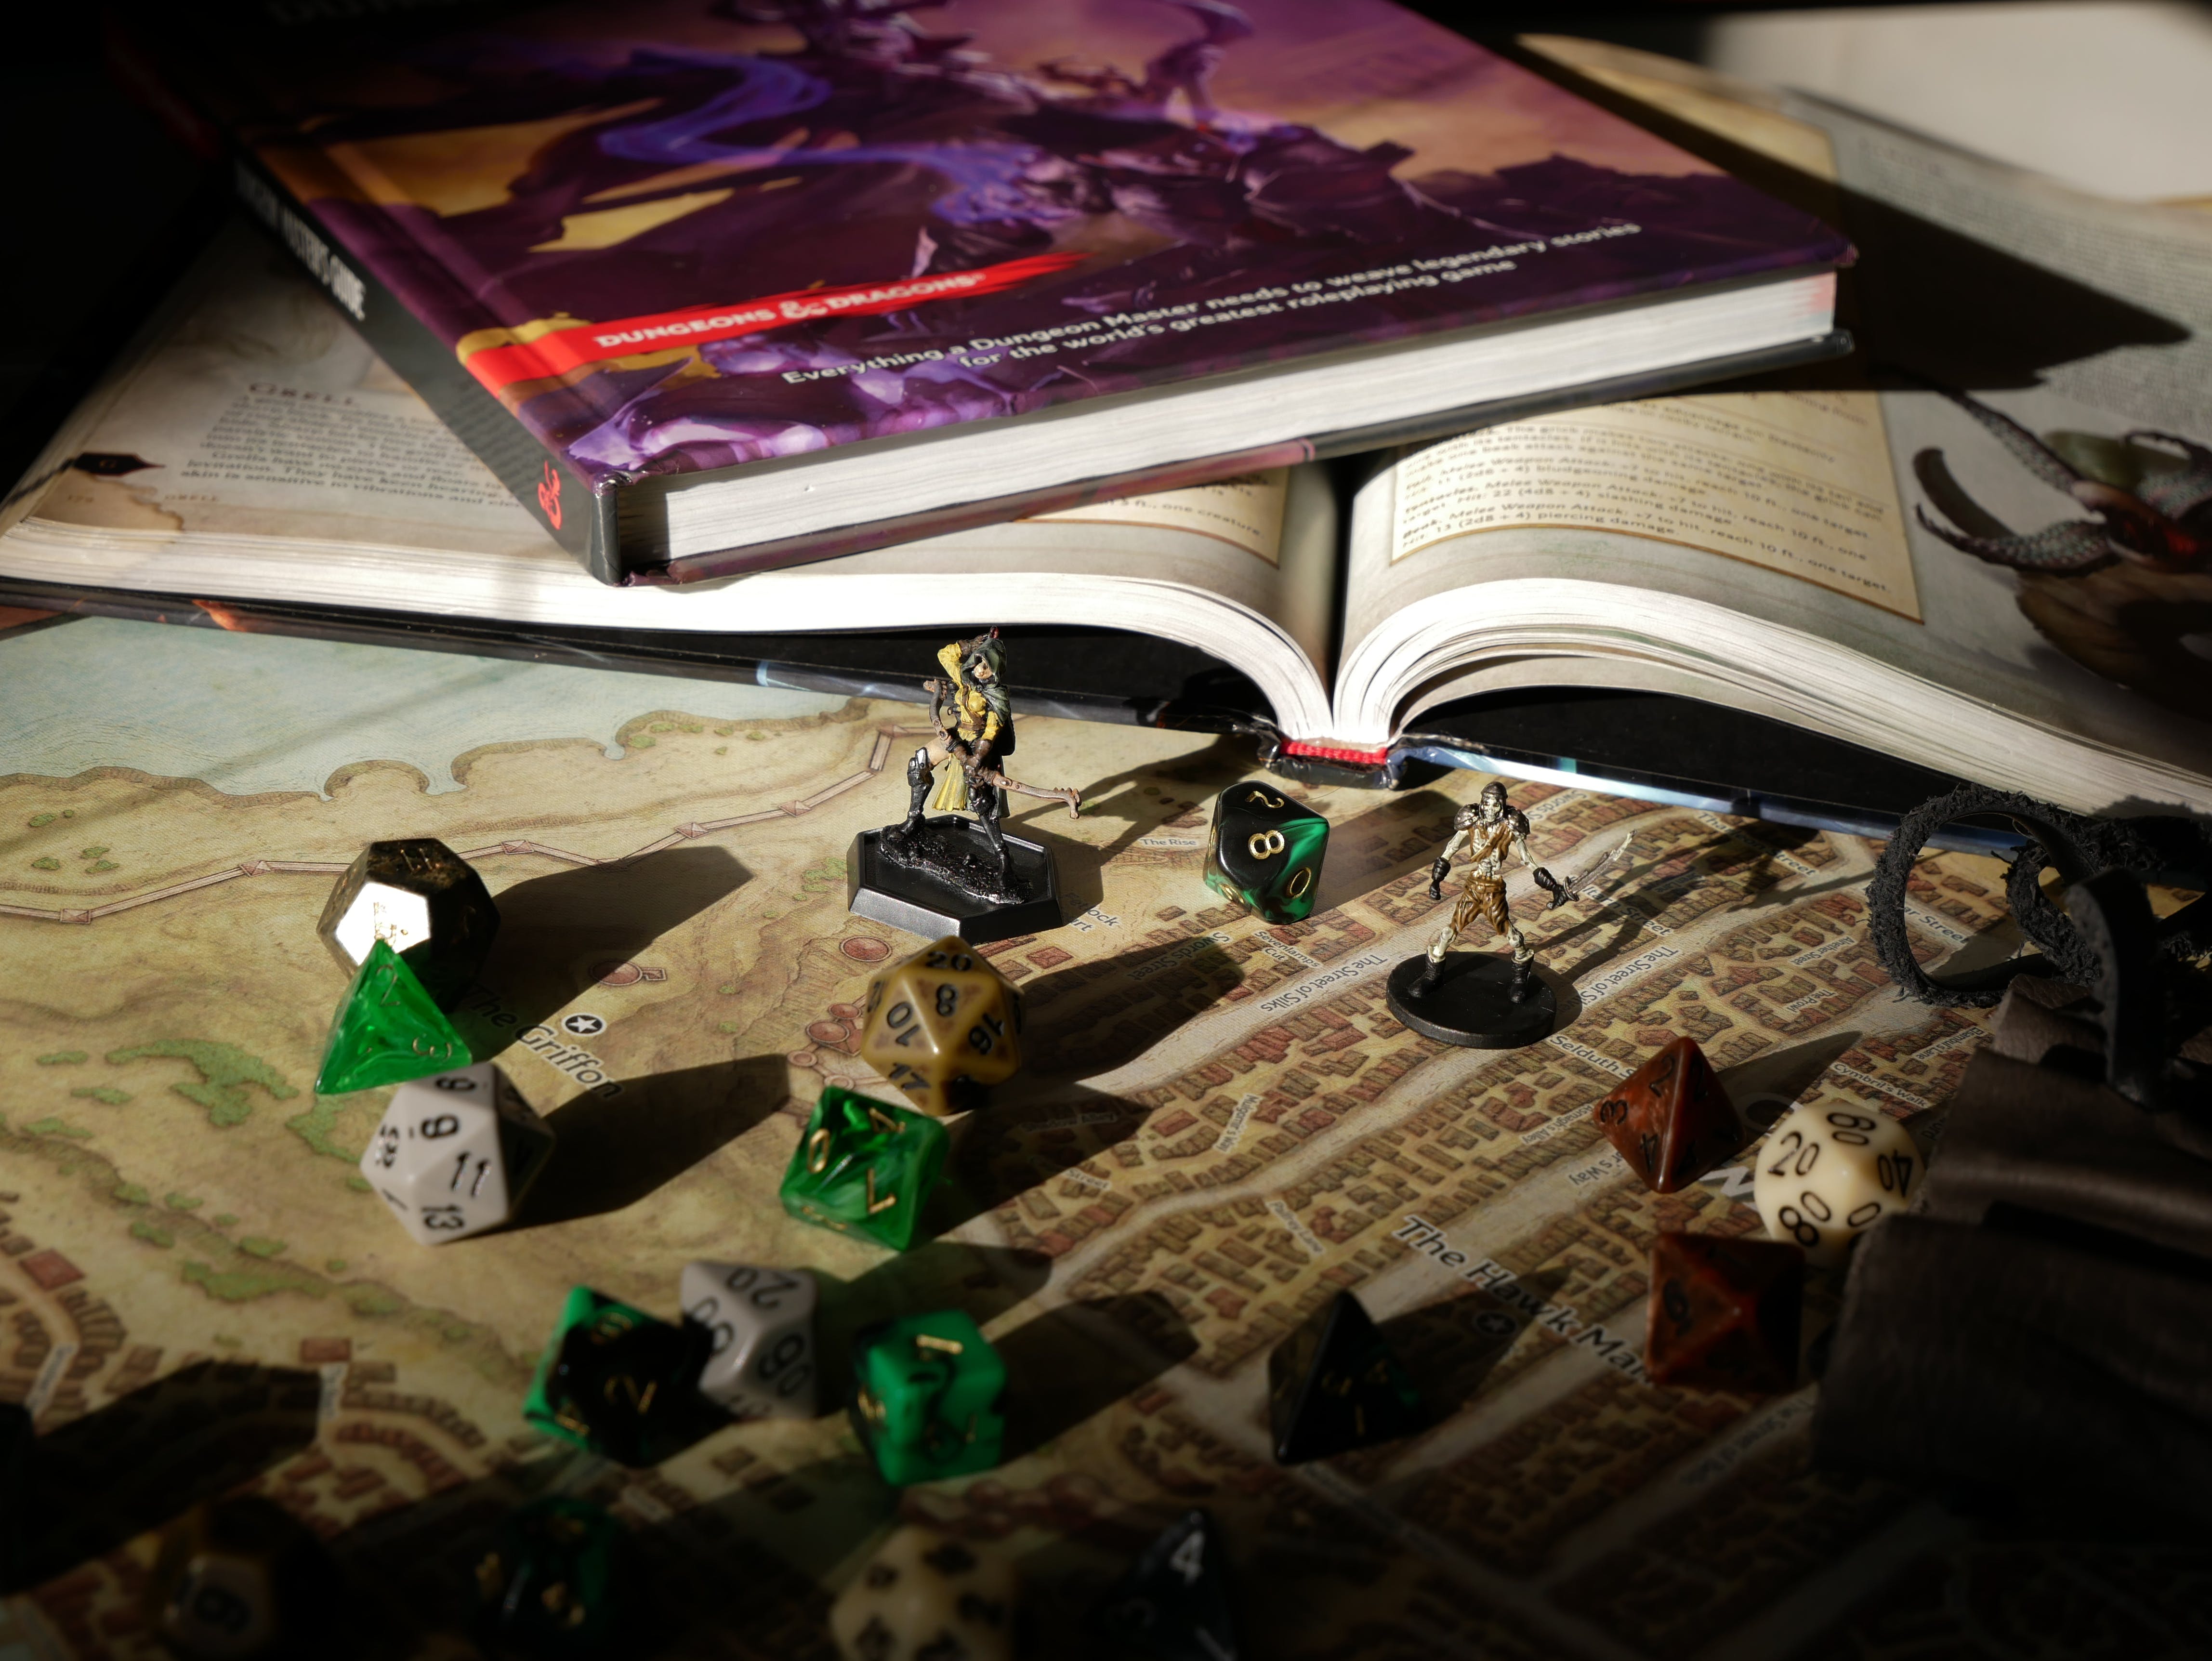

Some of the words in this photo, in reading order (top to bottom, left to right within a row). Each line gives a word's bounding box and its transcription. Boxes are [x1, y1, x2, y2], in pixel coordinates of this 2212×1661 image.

[782, 340, 945, 384] Everything
[948, 344, 967, 356] a
[968, 319, 1102, 352] Dungeon
[1103, 302, 1199, 327] Master
[1205, 286, 1290, 310] needs
[1292, 278, 1323, 293] to
[1326, 263, 1413, 288] weave
[1411, 238, 1547, 272] legendary
[1549, 222, 1642, 248] stories
[959, 351, 1002, 368] for
[1010, 342, 1058, 359] the
[1063, 322, 1165, 350] world's
[1168, 301, 1285, 332] greatest
[1286, 273, 1440, 310] roleplaying
[1441, 257, 1518, 283] game
[593, 308, 775, 348] DUNGEONS
[778, 300, 828, 320] &
[1440, 461, 1485, 476] Melee
[1491, 456, 1554, 467] Weapon
[1644, 467, 1659, 475] to
[1695, 479, 1738, 495] reach
[1744, 491, 1762, 503] 10
[1790, 506, 1820, 523] one
[1493, 488, 1512, 498] 22
[1596, 492, 1664, 510] slashing
[1162, 503, 1193, 514] one
[1197, 508, 1265, 540] creature.
[1485, 479, 1531, 489] Melee
[1537, 479, 1602, 489] Weapon
[1691, 500, 1708, 510] to
[1742, 514, 1785, 533] reach
[1791, 528, 1808, 541] 10
[1837, 546, 1868, 562] one
[1515, 512, 1531, 521] 4)
[1538, 512, 1605, 524] piercing
[1448, 506, 1495, 520] Melee
[1501, 502, 1567, 512] Weapon
[1658, 516, 1674, 525] to
[1710, 529, 1754, 547] reach
[1759, 541, 1778, 554] 10
[1807, 558, 1837, 573] one
[1840, 569, 1892, 594] target.
[1536, 790, 1588, 814] Swords
[1169, 838, 1197, 846] Rise
[1248, 830, 1285, 860] 8
[1620, 906, 1672, 936] Street
[1919, 915, 1970, 944] Street
[926, 950, 972, 972] 20
[1172, 931, 1231, 962] Swords
[1254, 930, 1320, 968] Sevenlamps
[1264, 948, 1286, 961] Cut
[1644, 947, 1679, 963] The
[1791, 951, 1822, 965] Street
[1128, 954, 1178, 982] Street
[1314, 965, 1359, 989] Street
[1351, 954, 1388, 970] The
[1610, 959, 1652, 985] Street
[936, 984, 959, 1017] 8
[1260, 992, 1301, 1012] Silks
[1298, 986, 1312, 999] of
[1591, 982, 1608, 996] of
[1812, 989, 1835, 1000] The
[1786, 999, 1818, 1013] Prowl
[886, 1001, 920, 1047] 10
[469, 983, 517, 1028] The
[517, 1026, 622, 1100] Griffon
[1550, 1035, 1619, 1072] Selduth
[1916, 1046, 1940, 1060] Lane
[888, 1062, 931, 1092] 17
[1834, 1063, 1895, 1093] Cymbril's
[1896, 1089, 1928, 1107] Walk
[1218, 1136, 1238, 1152] Way
[1522, 1128, 1550, 1145] Alley
[1767, 1131, 1820, 1176] 20
[451, 1152, 490, 1197] 11
[1568, 1166, 1609, 1186] Way
[1877, 1149, 1913, 1199] 40
[422, 1204, 464, 1230] 13
[1778, 1191, 1831, 1248] 80
[726, 1267, 800, 1308] 20
[1397, 1216, 1465, 1267] The
[1465, 1261, 1580, 1334] Hawk
[1168, 1528, 1207, 1589] 4
